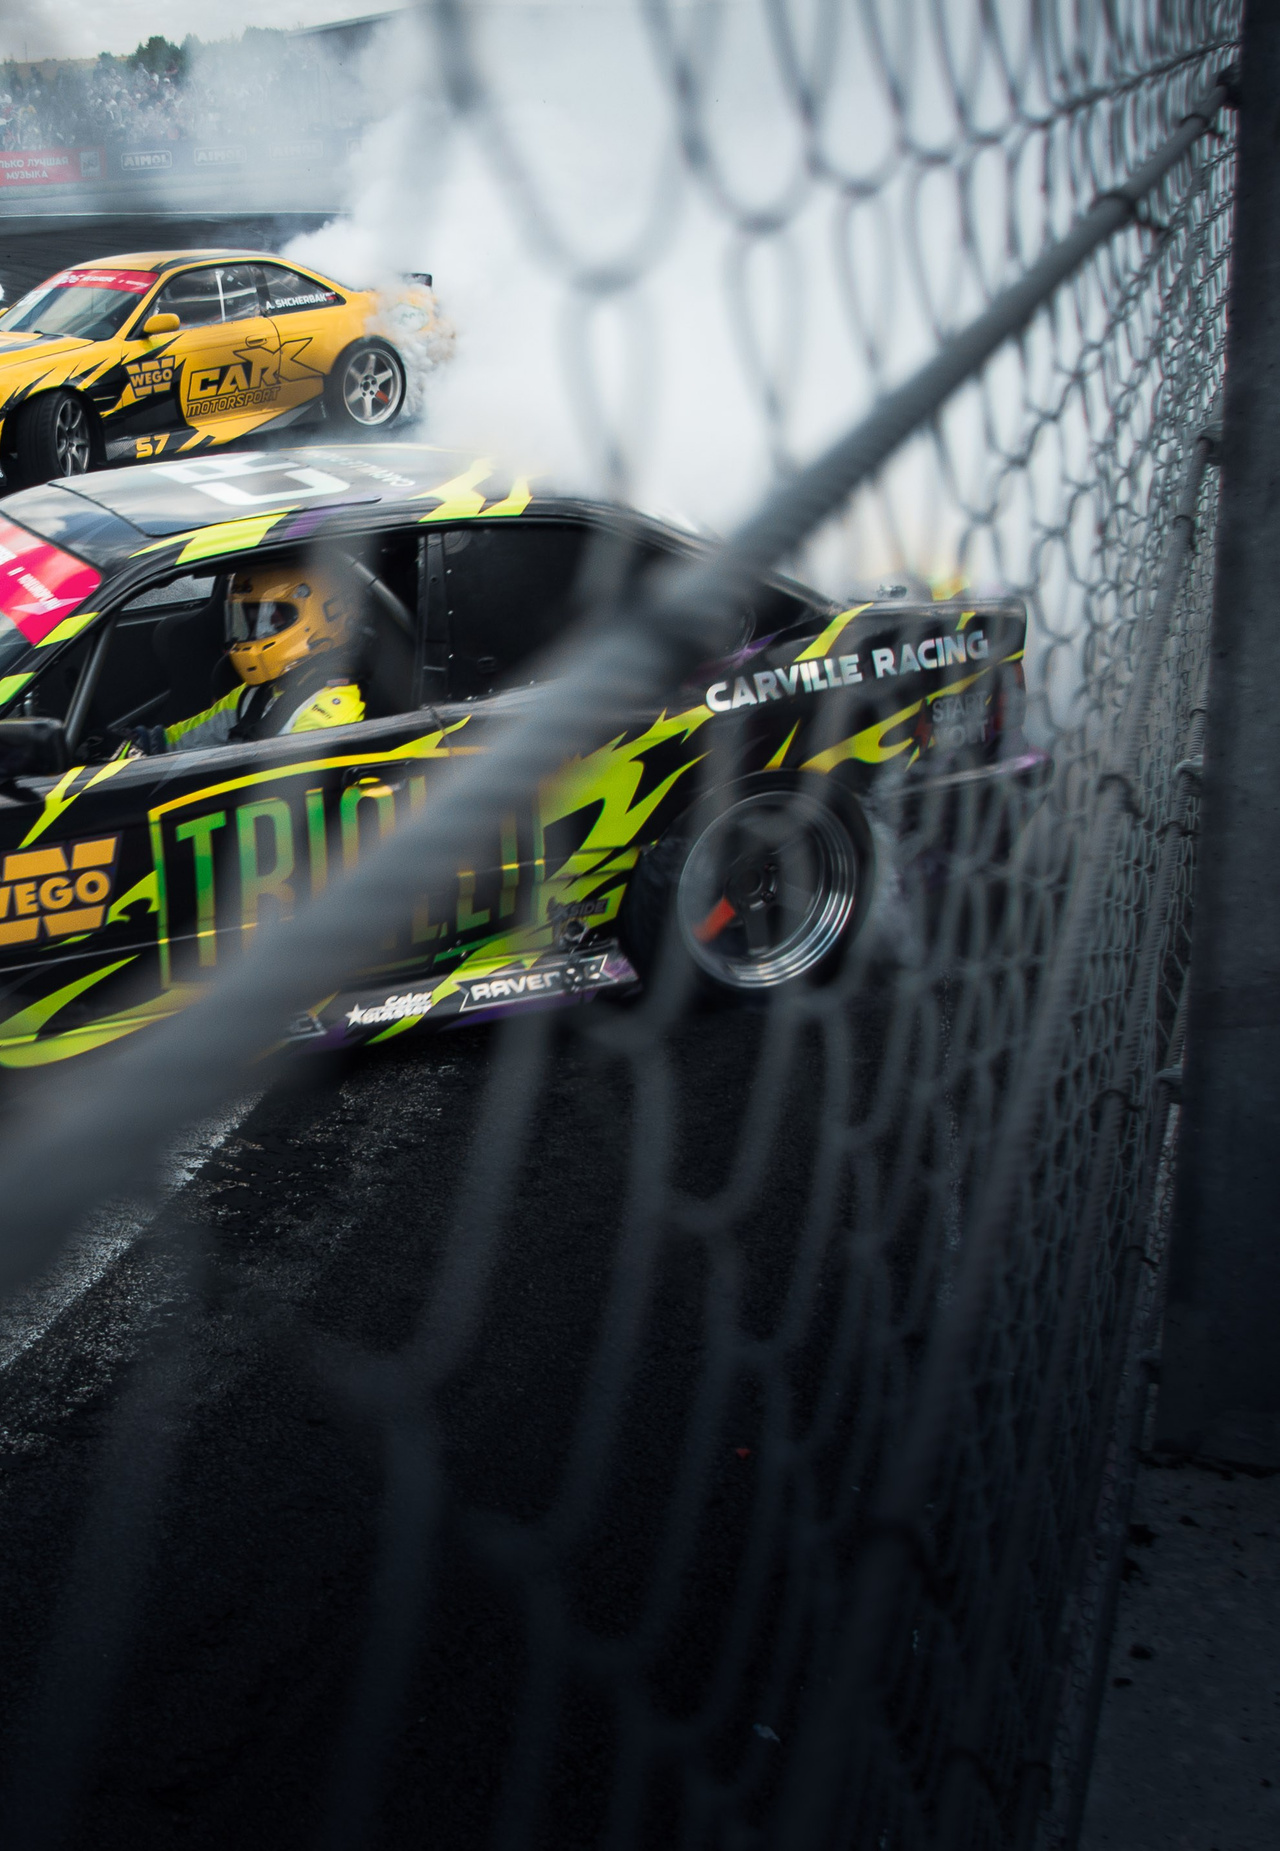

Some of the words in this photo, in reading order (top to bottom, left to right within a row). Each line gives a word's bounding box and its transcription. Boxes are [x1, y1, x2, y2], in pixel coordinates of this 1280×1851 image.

[28, 156, 69, 168] ЛУЧШАЯ
[124, 155, 167, 167] AIMOL
[6, 170, 48, 181] МУЗЫКА
[276, 293, 327, 309] SHCHERBAK
[130, 368, 173, 388] WEGO
[186, 387, 281, 418] MOTORSPORT
[136, 434, 170, 459] 57
[705, 654, 863, 713] CARVILLE
[872, 630, 989, 680] RACING
